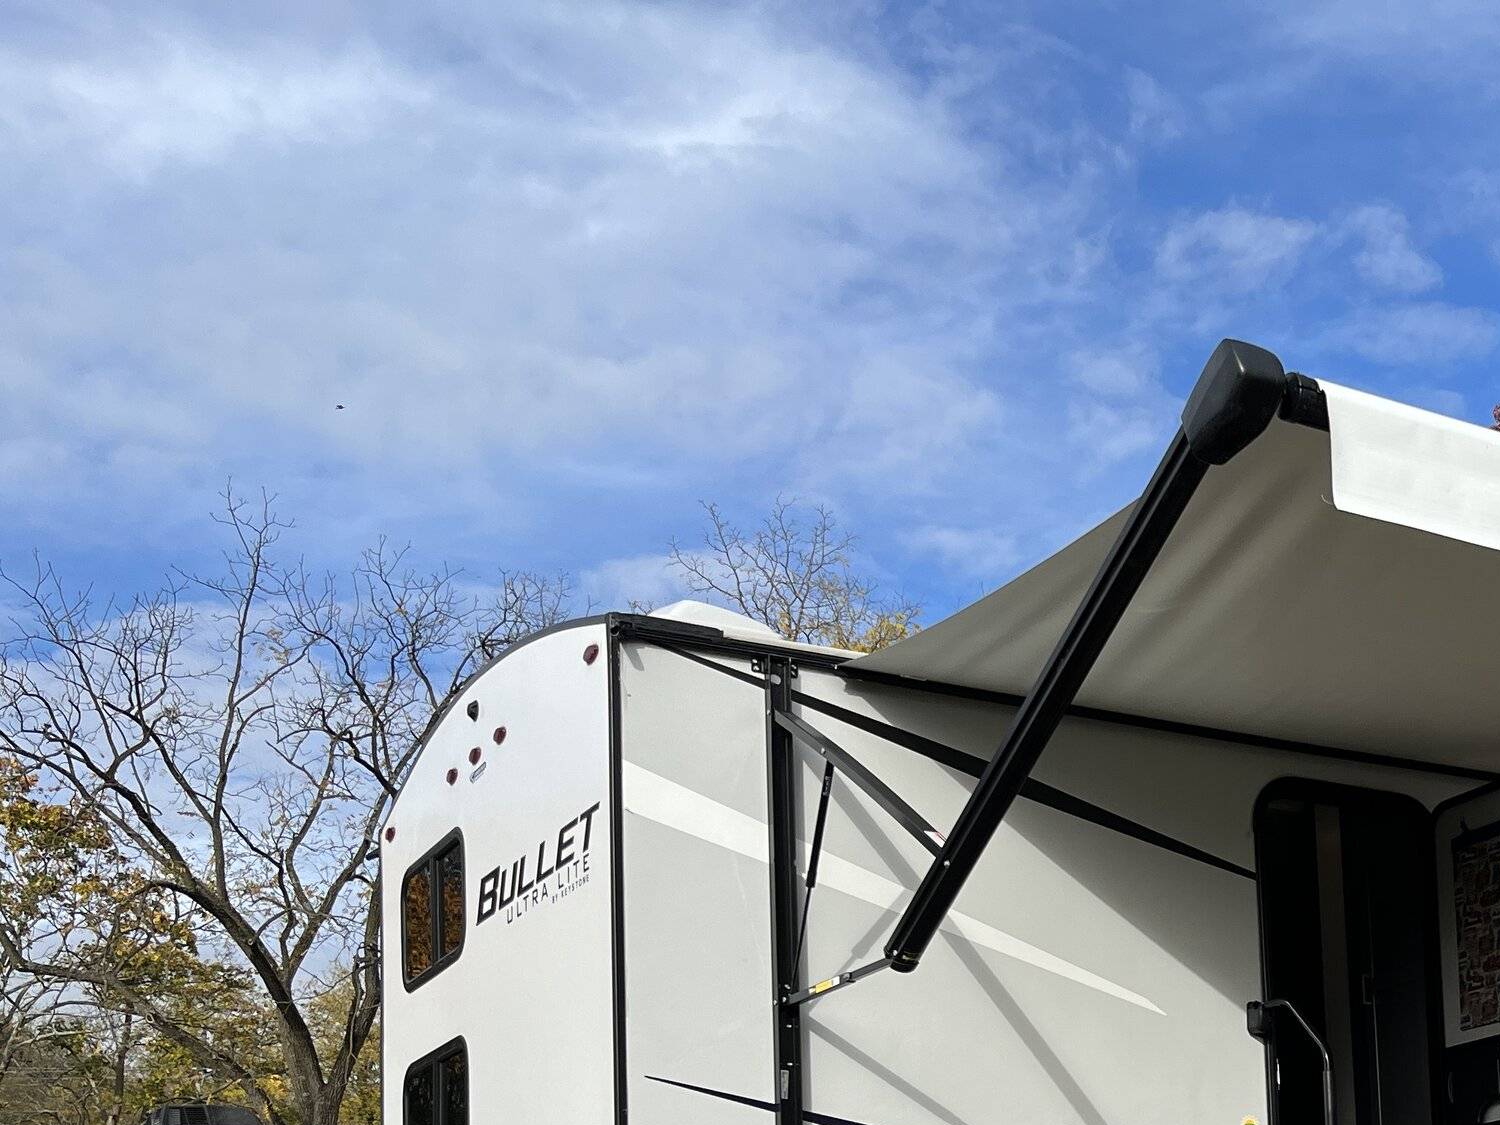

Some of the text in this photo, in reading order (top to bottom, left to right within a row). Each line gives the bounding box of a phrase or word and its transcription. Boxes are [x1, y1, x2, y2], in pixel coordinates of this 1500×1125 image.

[476, 801, 600, 926] BULLET
[506, 853, 590, 924] ULTRA LITE
[561, 874, 590, 898] KEYSTONE
